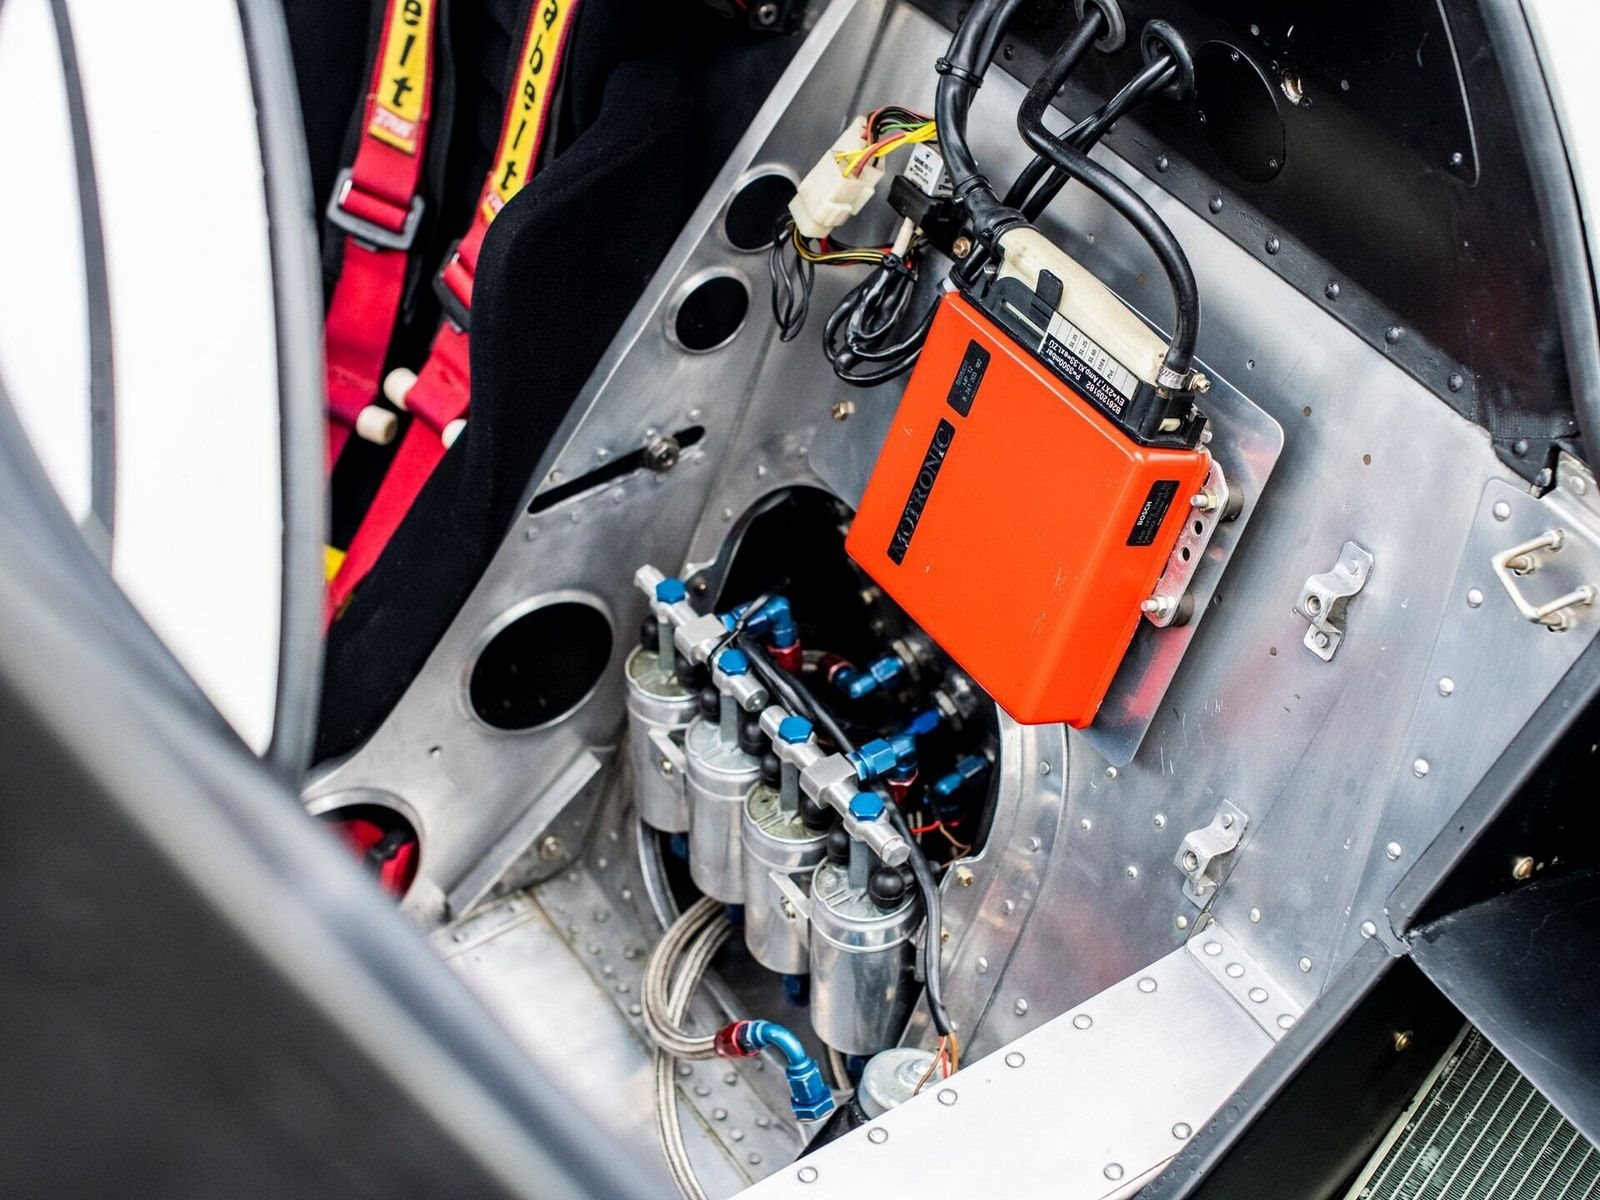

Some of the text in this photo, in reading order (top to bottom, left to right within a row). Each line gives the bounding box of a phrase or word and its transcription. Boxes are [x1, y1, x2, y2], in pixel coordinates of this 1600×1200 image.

[1045, 348, 1122, 415] B261205182 P=3500mbar
[892, 427, 951, 558] MOTRONIC
[1136, 501, 1153, 526] BOSCH
